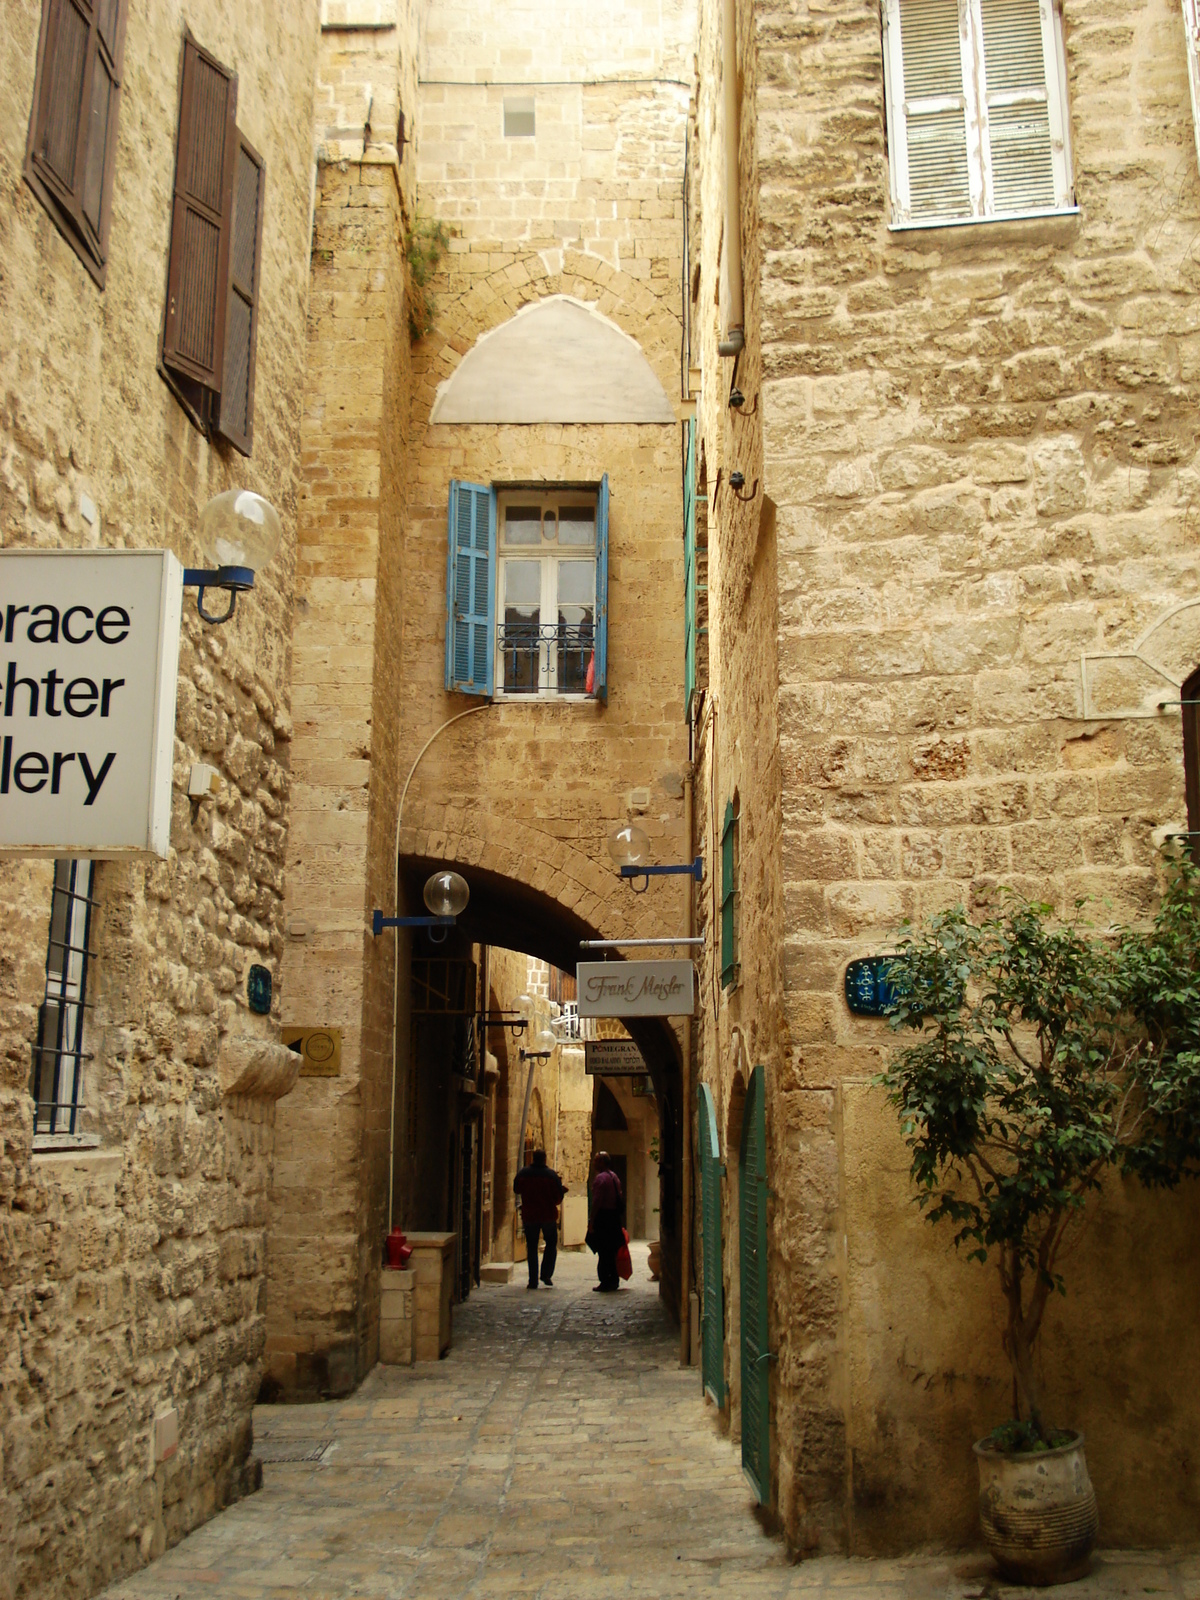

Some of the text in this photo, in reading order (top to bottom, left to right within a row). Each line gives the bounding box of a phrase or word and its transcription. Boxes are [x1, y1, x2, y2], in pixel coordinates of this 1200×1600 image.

[0, 604, 131, 644] race
[0, 662, 125, 718] hter
[0, 735, 117, 805] lery
[585, 974, 686, 1003] Frank Meisler
[592, 1044, 639, 1053] POMEGRAN
